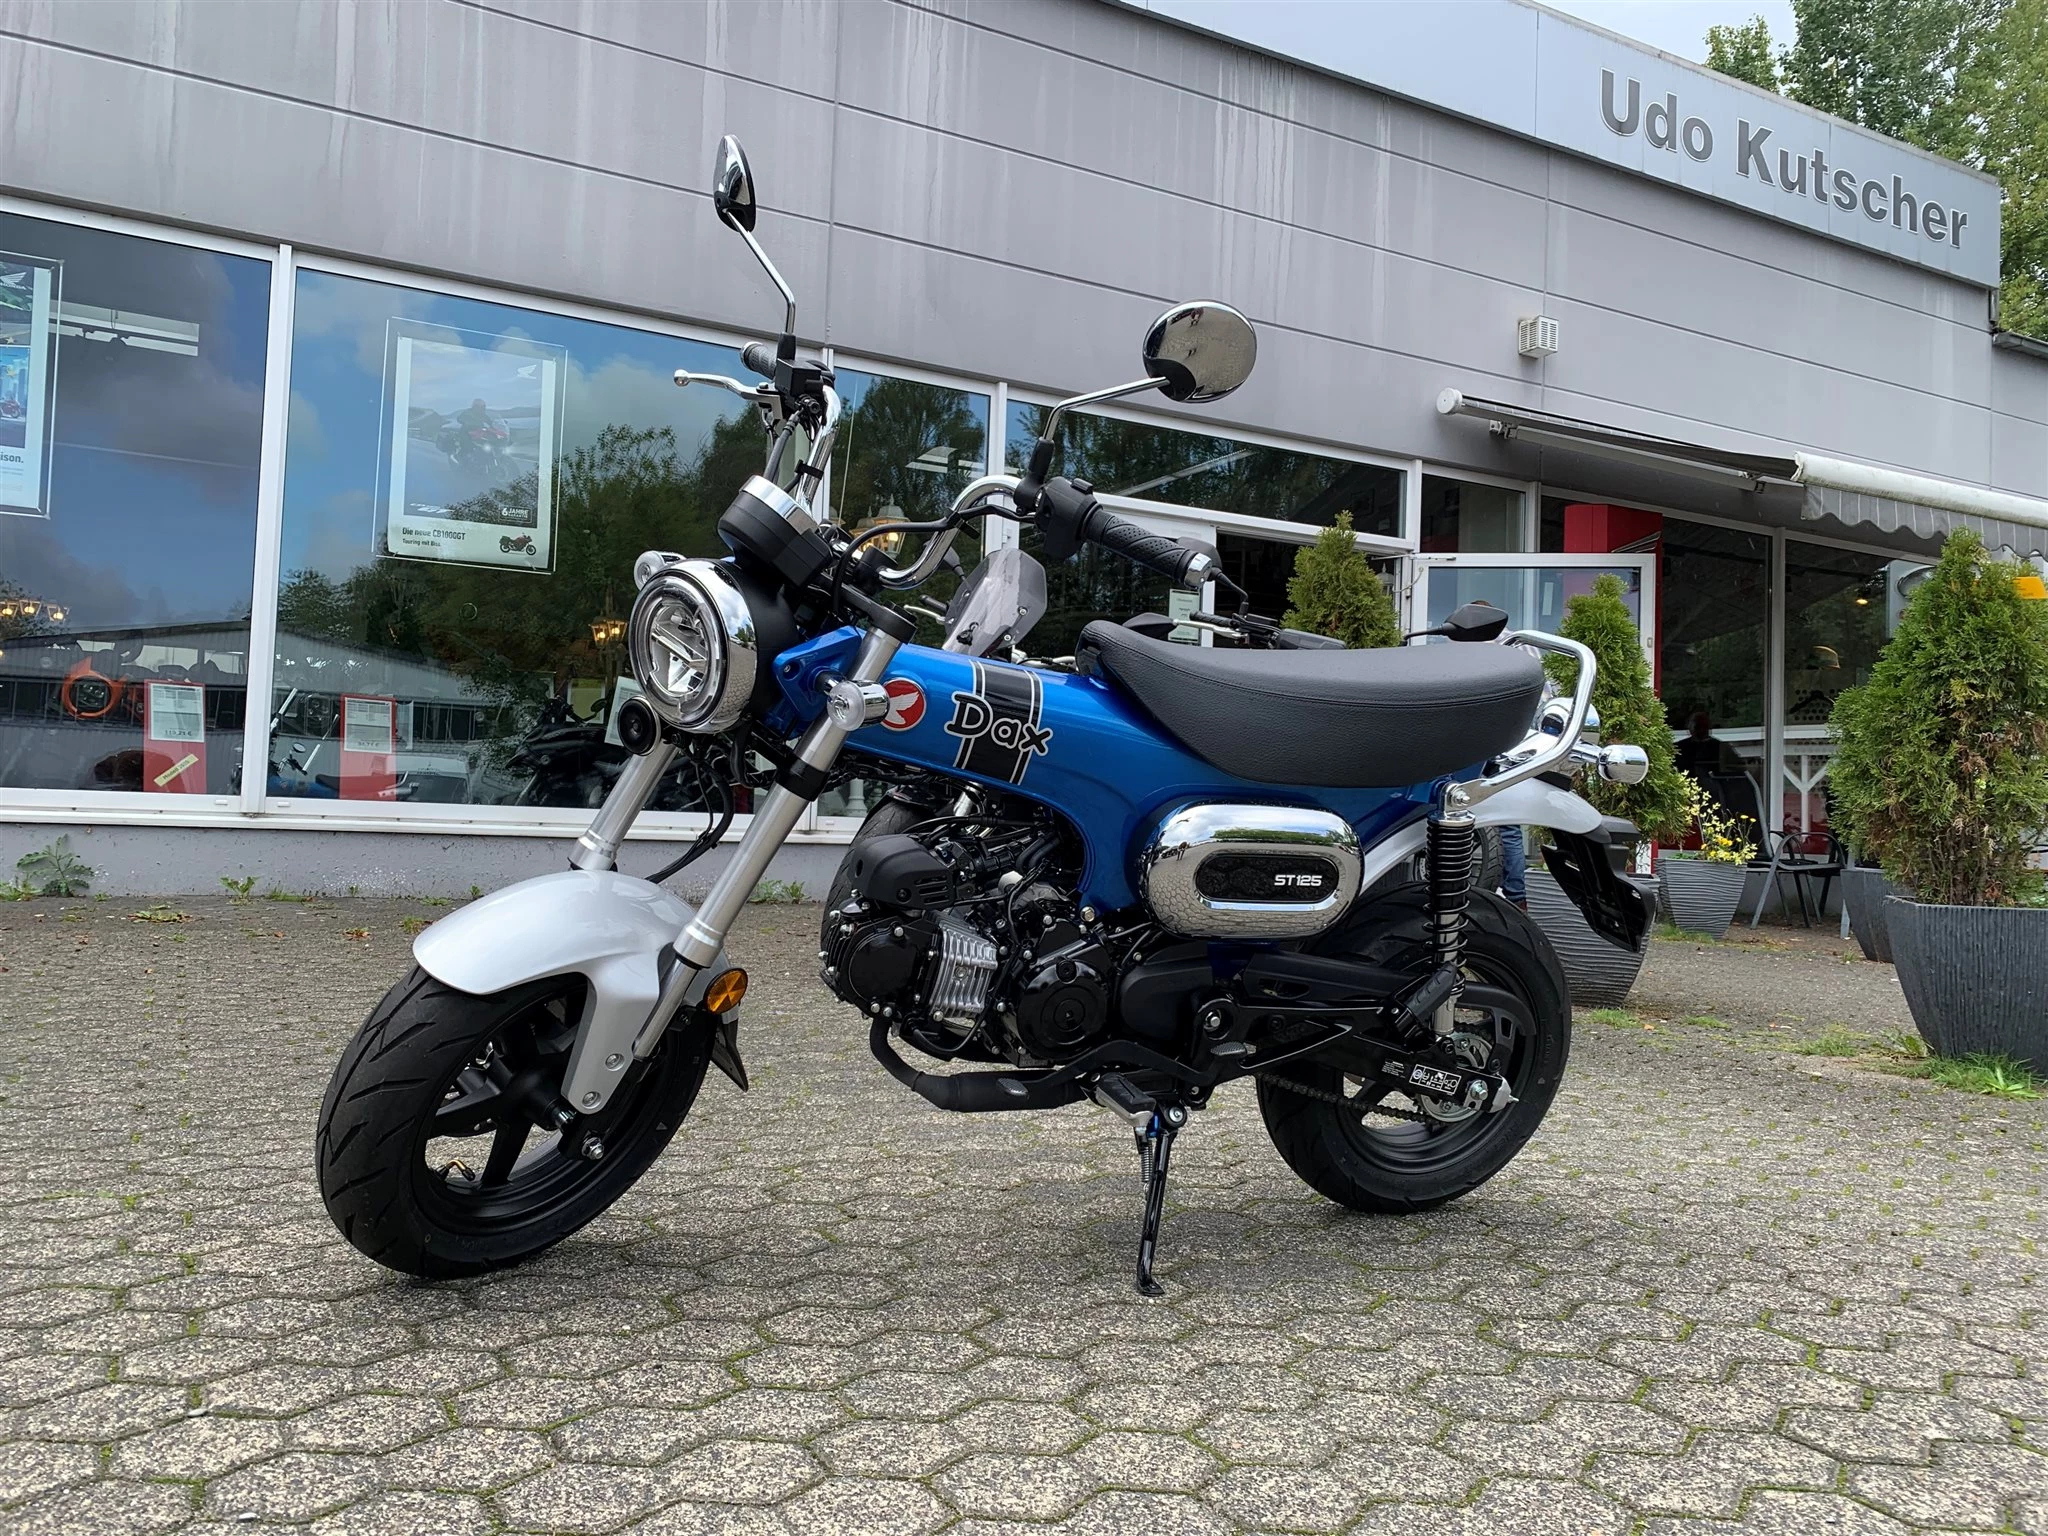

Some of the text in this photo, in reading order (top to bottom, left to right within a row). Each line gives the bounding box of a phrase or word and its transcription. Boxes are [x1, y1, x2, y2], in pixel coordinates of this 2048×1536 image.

[1600, 67, 1968, 248] Udo Kutscher
[402, 527, 413, 536] Die
[944, 691, 1054, 757] Dax
[1274, 874, 1323, 887] ST125
